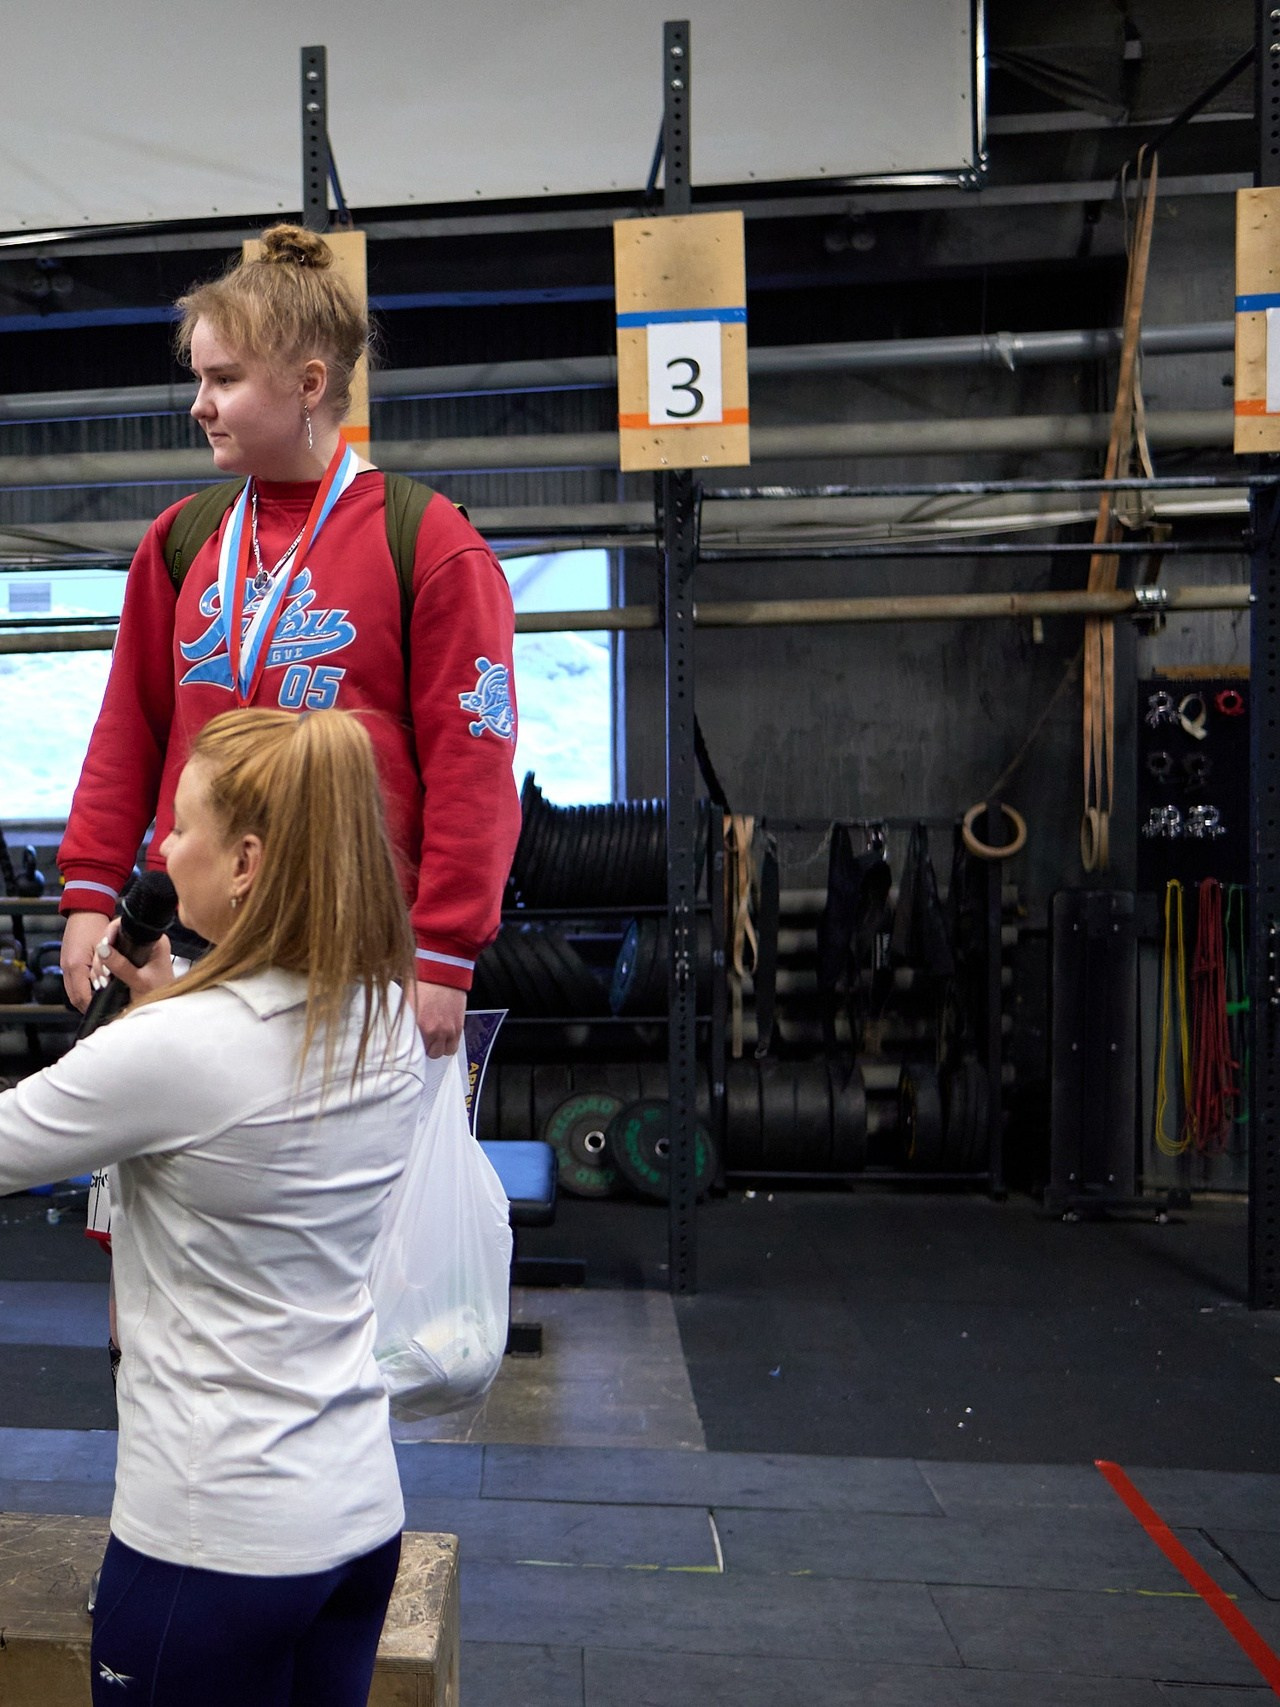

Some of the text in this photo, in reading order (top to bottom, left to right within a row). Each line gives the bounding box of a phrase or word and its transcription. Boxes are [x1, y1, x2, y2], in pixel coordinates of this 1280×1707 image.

[665, 357, 704, 418] 3
[271, 647, 303, 662] GUE
[278, 664, 347, 709] 05
